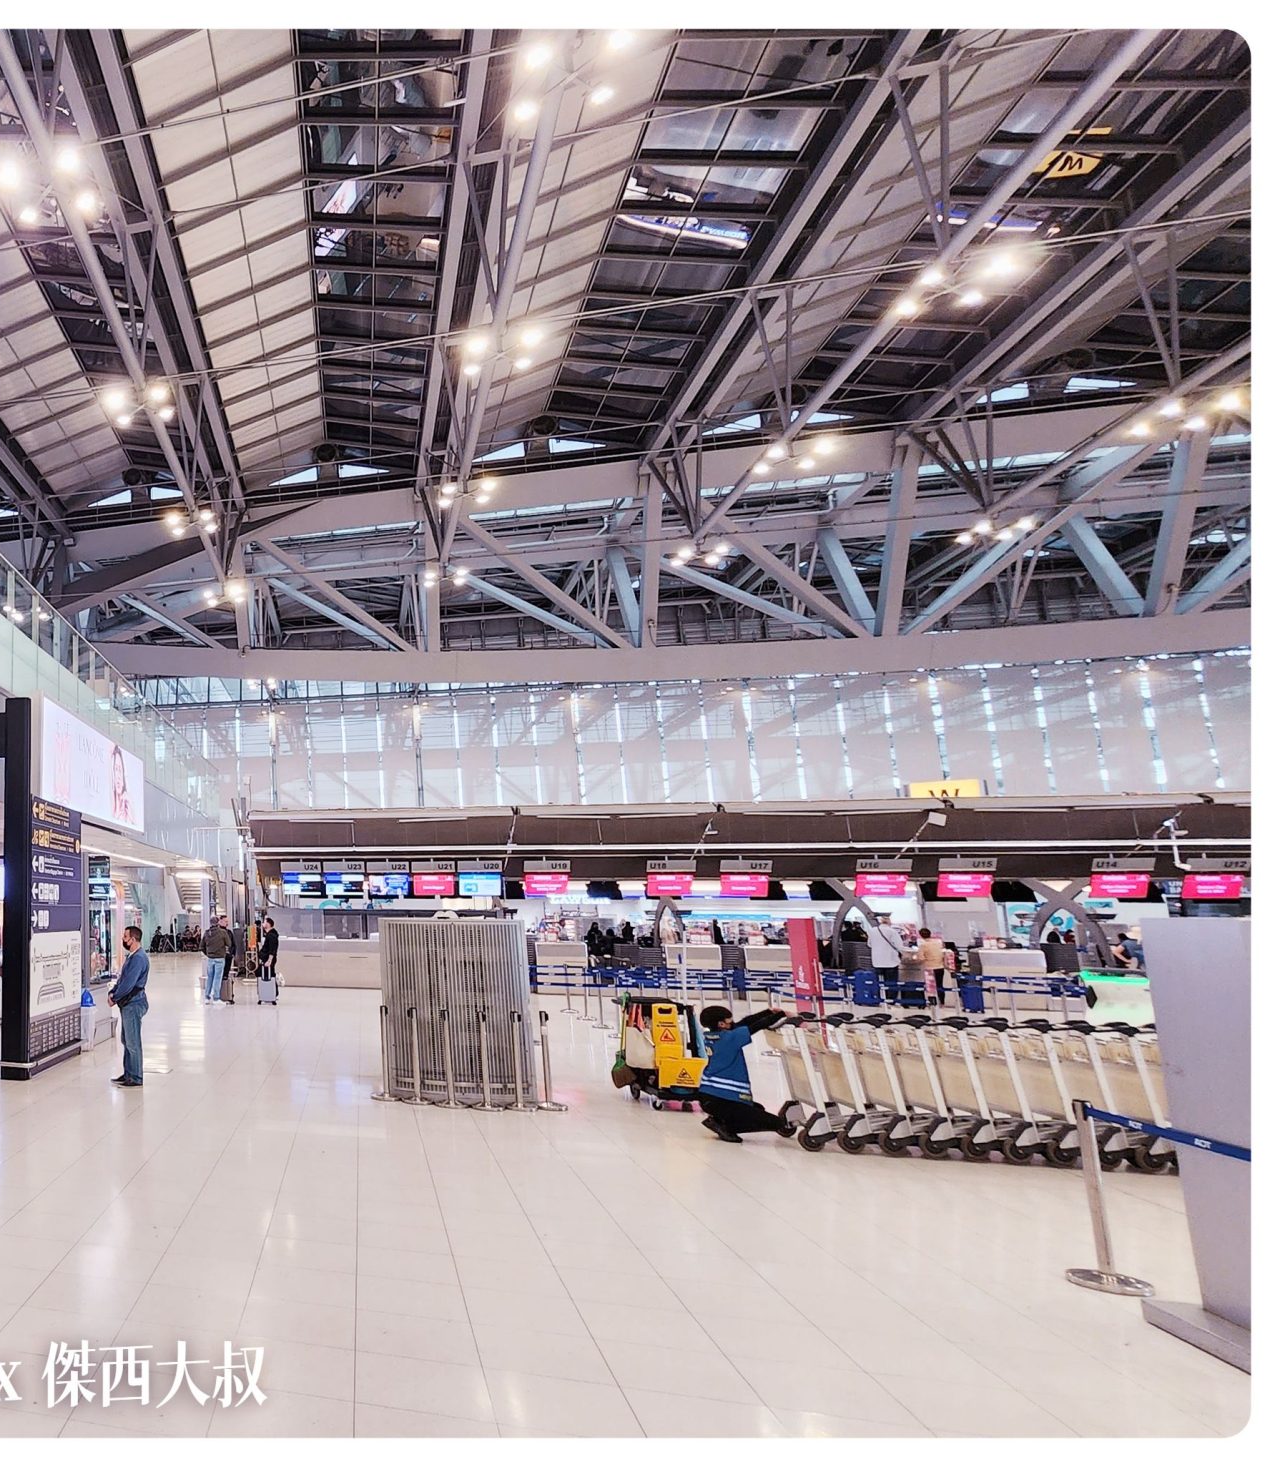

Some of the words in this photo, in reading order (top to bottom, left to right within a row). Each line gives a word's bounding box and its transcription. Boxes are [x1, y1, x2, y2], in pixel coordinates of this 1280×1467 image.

[304, 863, 319, 871] U24
[391, 863, 406, 871] U22
[551, 862, 568, 870] U19
